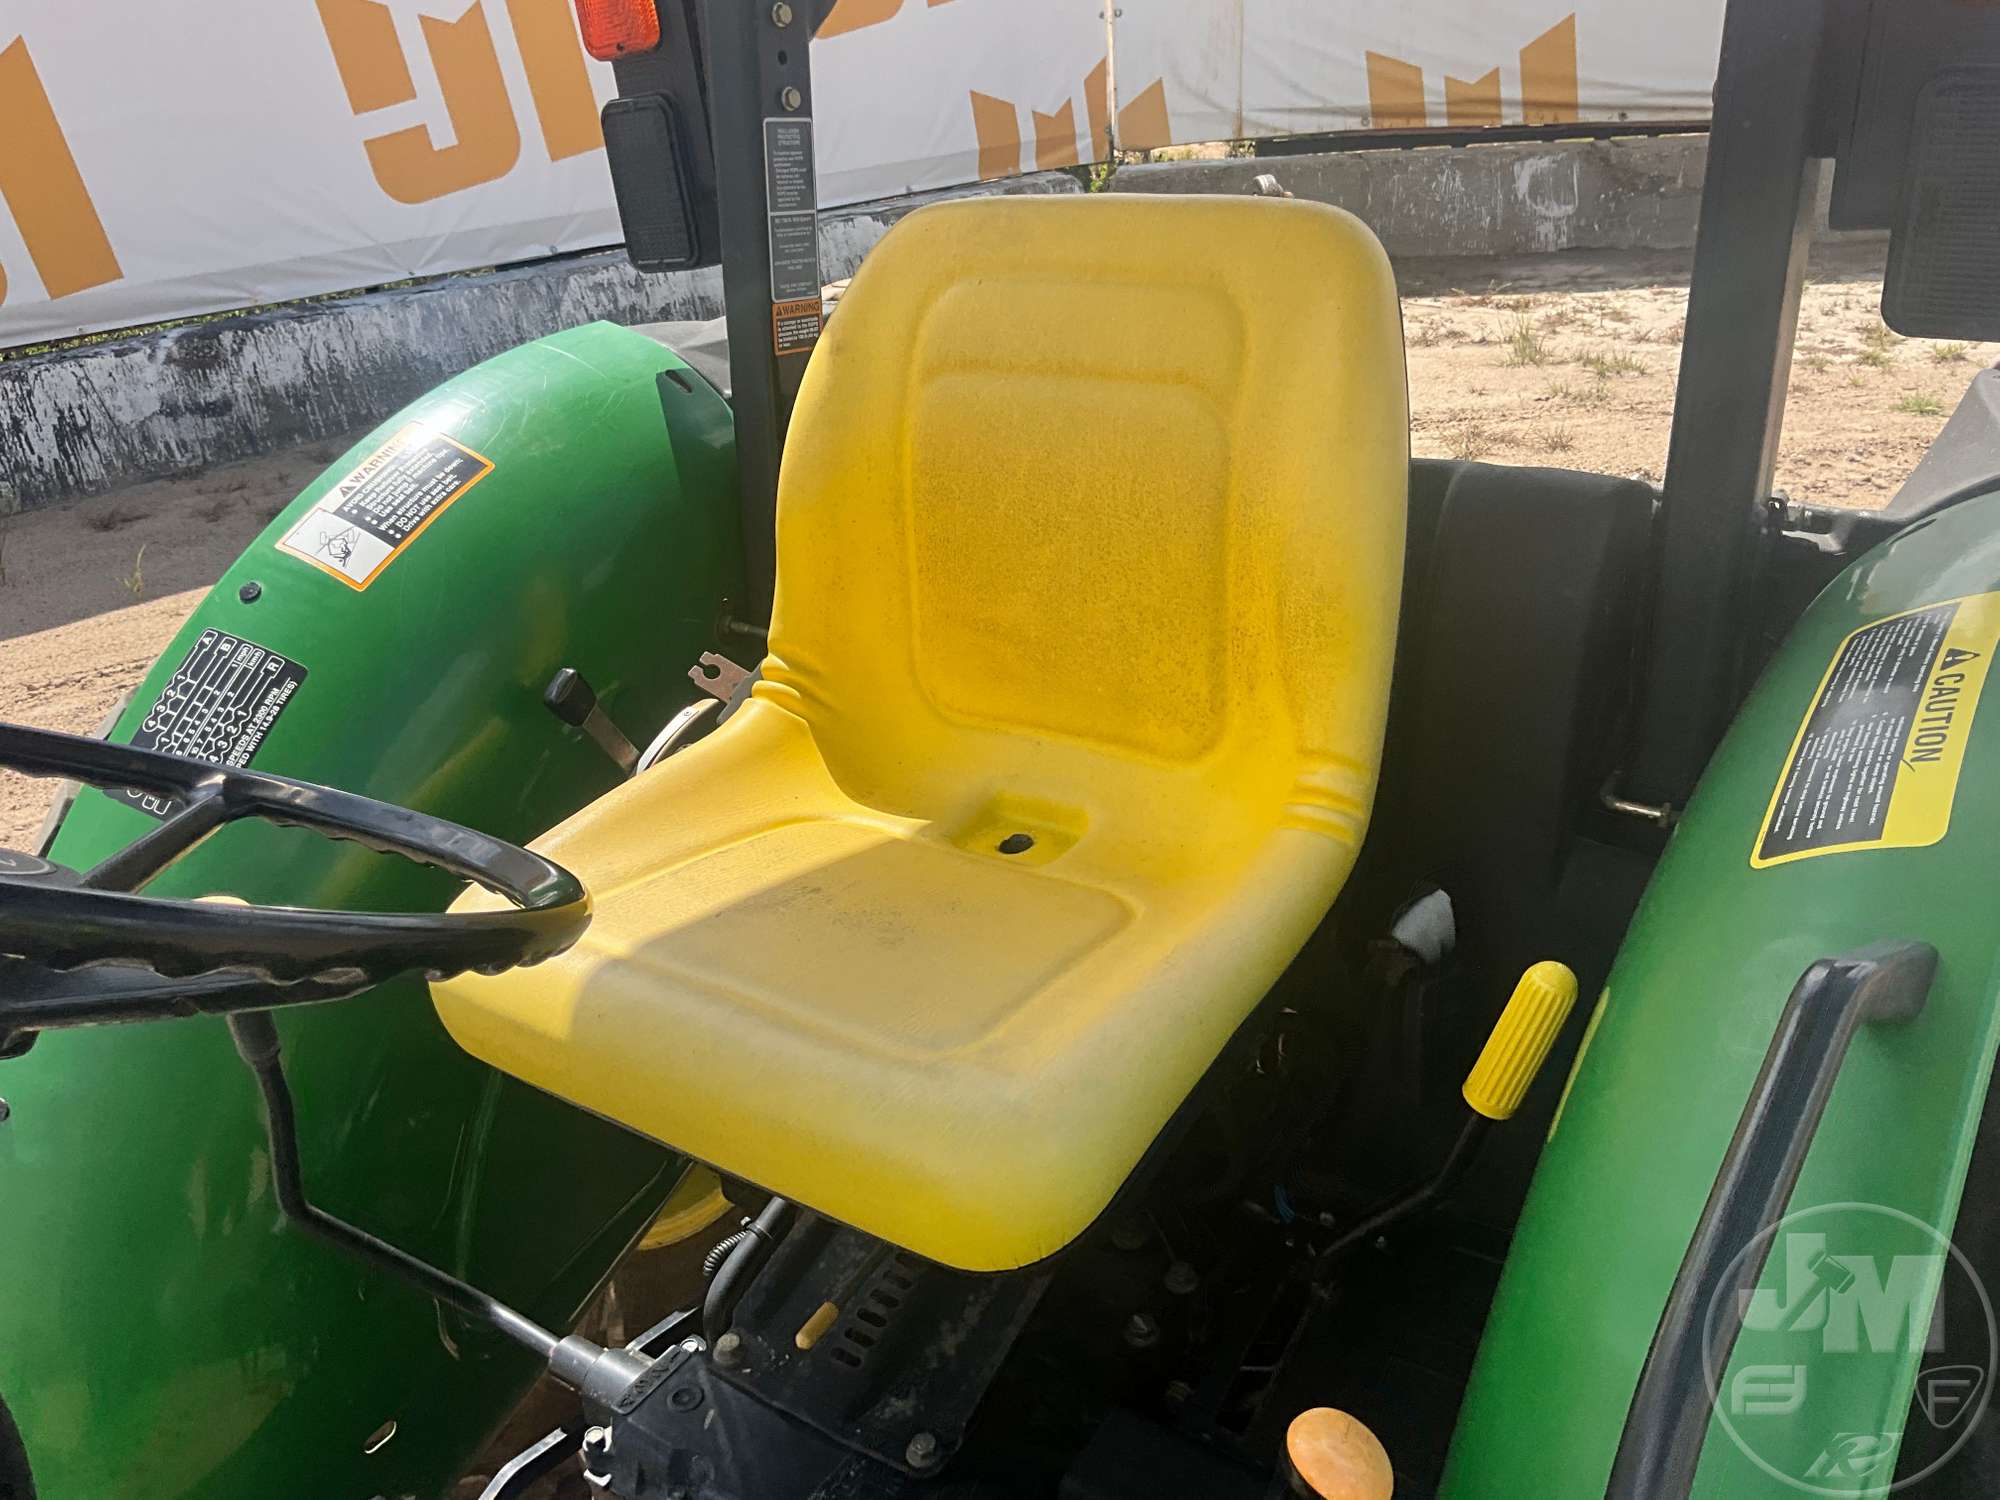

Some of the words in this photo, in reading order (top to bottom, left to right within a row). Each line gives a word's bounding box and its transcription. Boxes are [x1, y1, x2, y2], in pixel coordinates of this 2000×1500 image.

[783, 302, 820, 316] WARNING
[350, 438, 404, 483] WARNIN
[377, 515, 398, 531] When
[396, 491, 423, 515] structure
[421, 478, 438, 492] must
[377, 506, 393, 517] Use
[391, 493, 406, 506] seat
[395, 517, 408, 528] DO
[405, 504, 420, 518] NOT
[419, 495, 432, 505] use
[430, 483, 444, 496] seat
[402, 516, 420, 532] Drive
[418, 504, 433, 516] with
[431, 491, 447, 505] extra
[166, 689, 176, 697] 2
[202, 637, 212, 645] A
[220, 643, 231, 652] B
[237, 647, 250, 661] mph
[209, 755, 219, 763] 4
[217, 740, 228, 749] 3
[227, 725, 238, 734] 2
[267, 662, 279, 672] R
[226, 734, 249, 766] SPEEDS
[246, 723, 256, 734] AT
[264, 688, 280, 705] RPM
[1910, 673, 1965, 762] CAUTION
[245, 731, 263, 751] WITH
